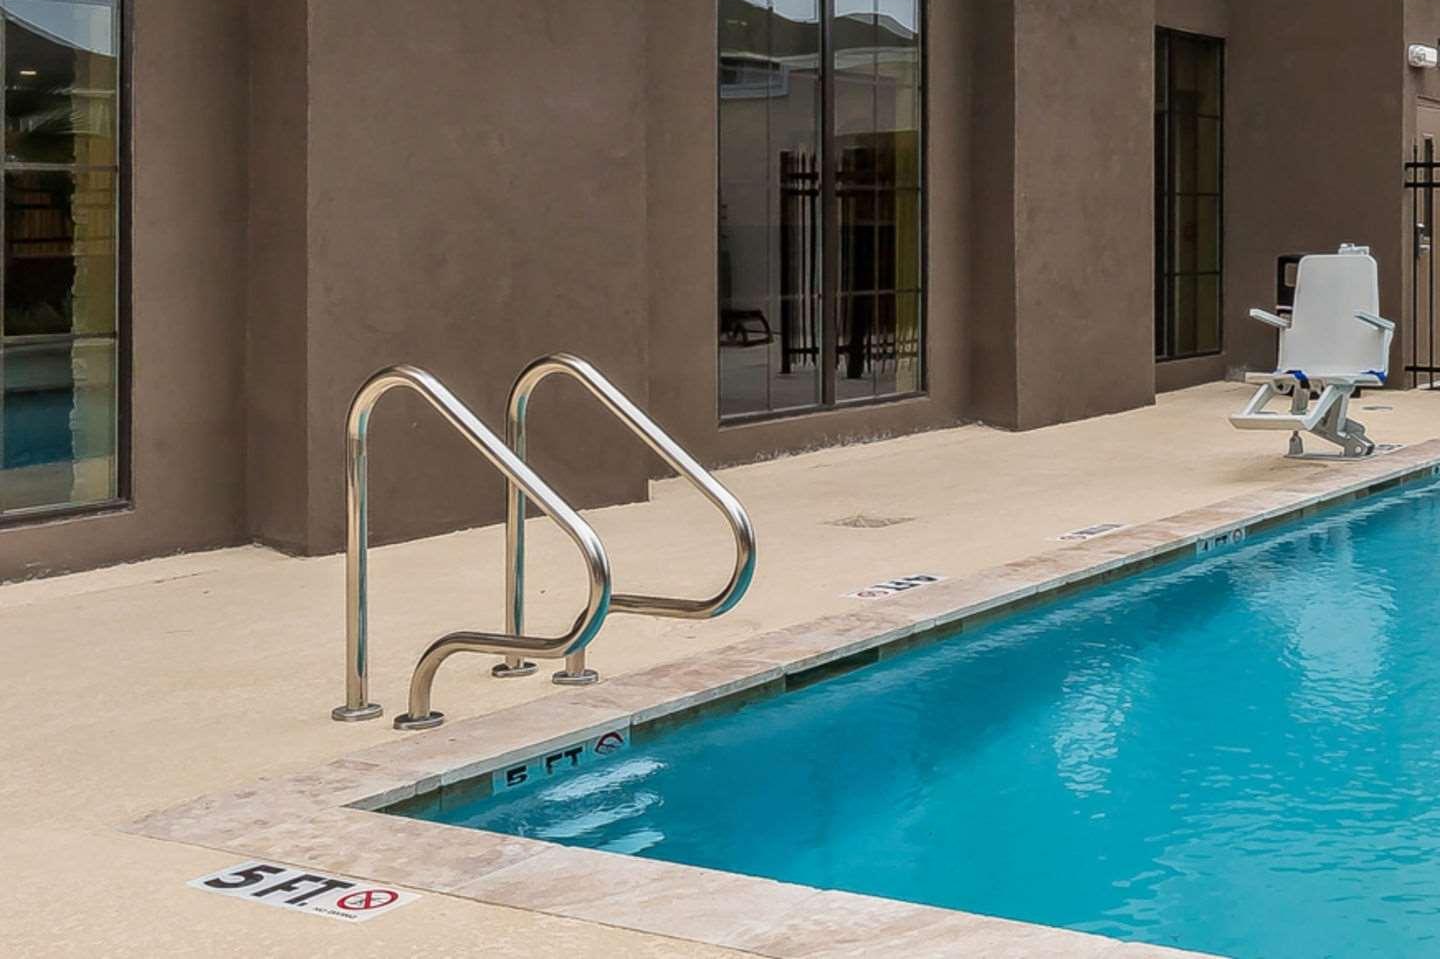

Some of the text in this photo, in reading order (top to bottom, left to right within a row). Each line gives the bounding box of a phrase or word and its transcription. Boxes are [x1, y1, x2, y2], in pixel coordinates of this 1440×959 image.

[506, 746, 583, 787] 5 FT
[203, 864, 287, 889] 5
